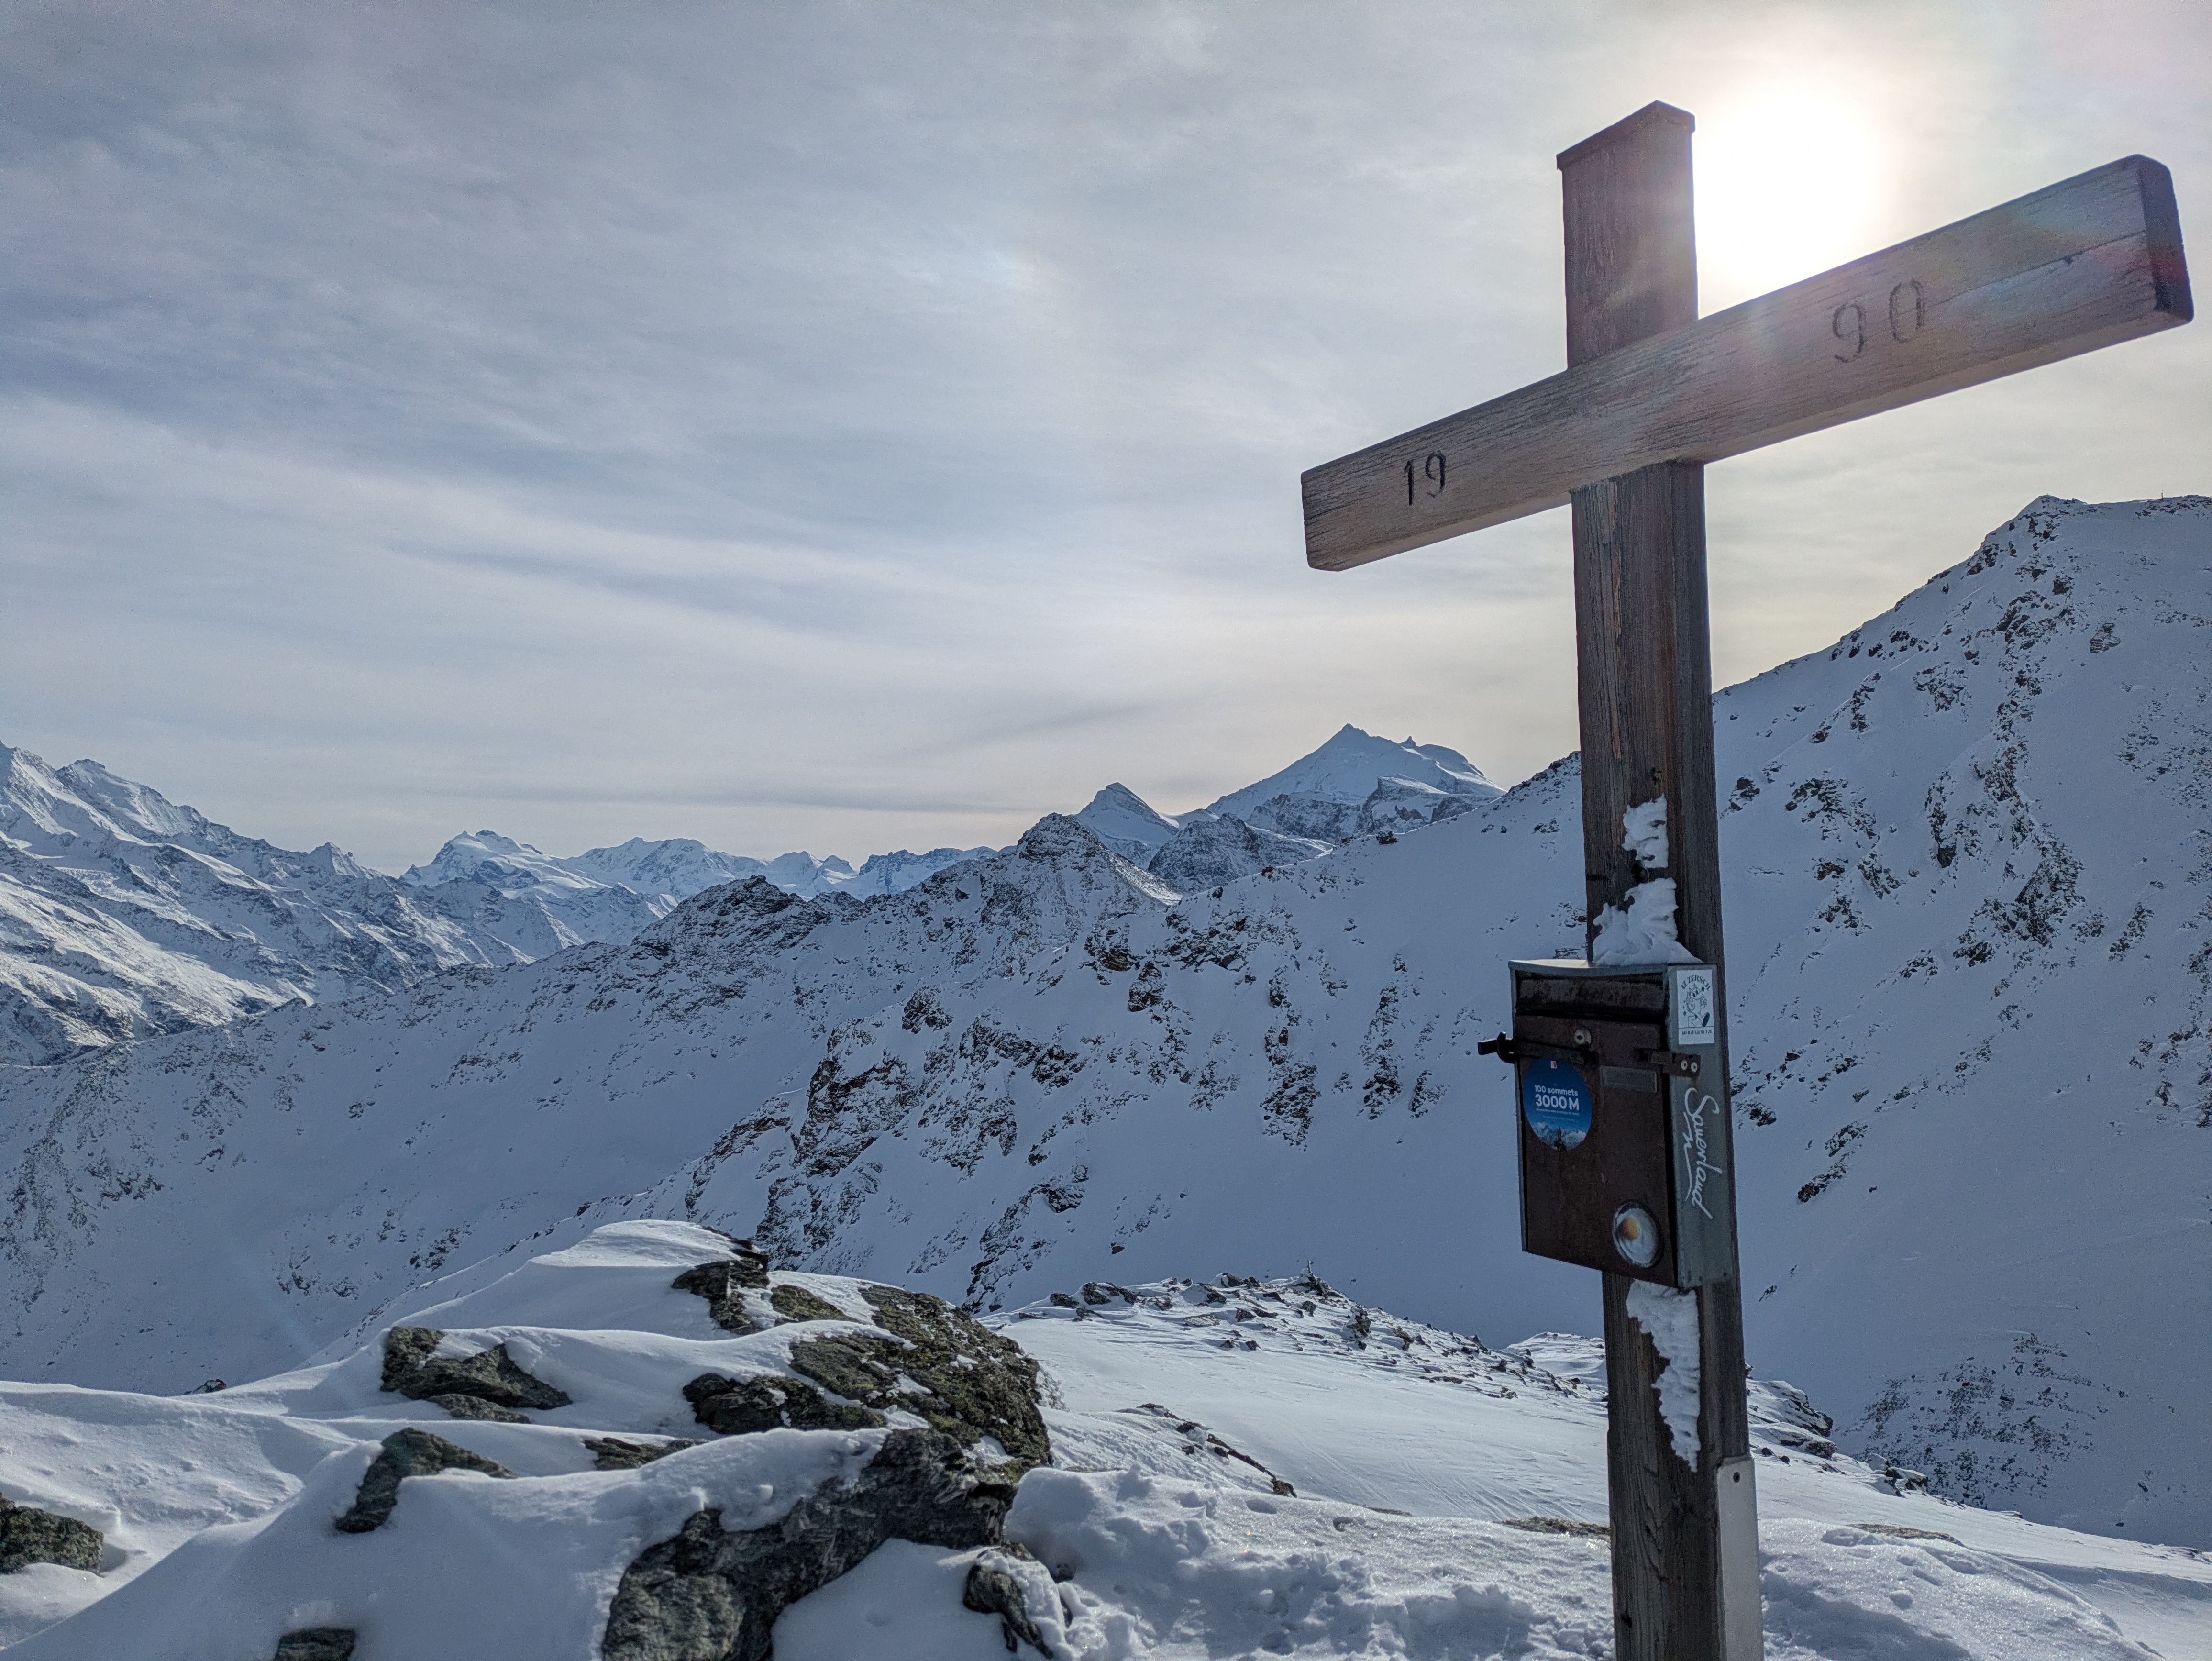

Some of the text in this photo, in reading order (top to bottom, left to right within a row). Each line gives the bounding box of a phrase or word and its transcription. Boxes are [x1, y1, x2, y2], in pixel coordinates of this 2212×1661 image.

[1404, 278, 1925, 506] 19 90
[1534, 1085, 1546, 1093] 100
[1548, 1087, 1578, 1096] sommets
[1535, 1094, 1580, 1111] 3000 M
